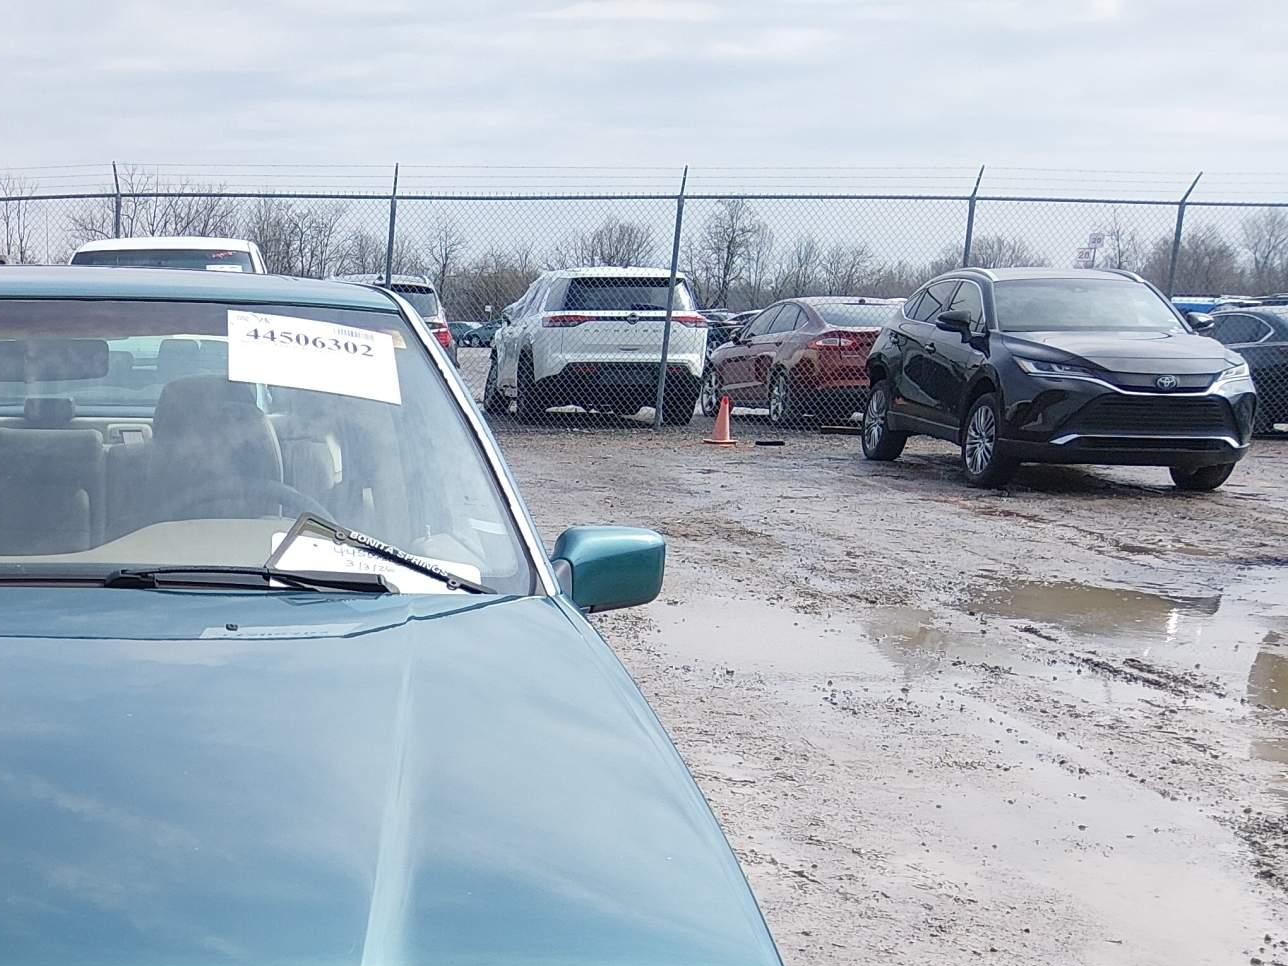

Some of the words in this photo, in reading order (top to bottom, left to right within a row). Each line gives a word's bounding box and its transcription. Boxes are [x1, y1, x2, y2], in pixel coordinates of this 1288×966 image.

[245, 328, 374, 357] 44506302
[349, 531, 394, 554] BONITA
[397, 551, 448, 576] SPRINGS
